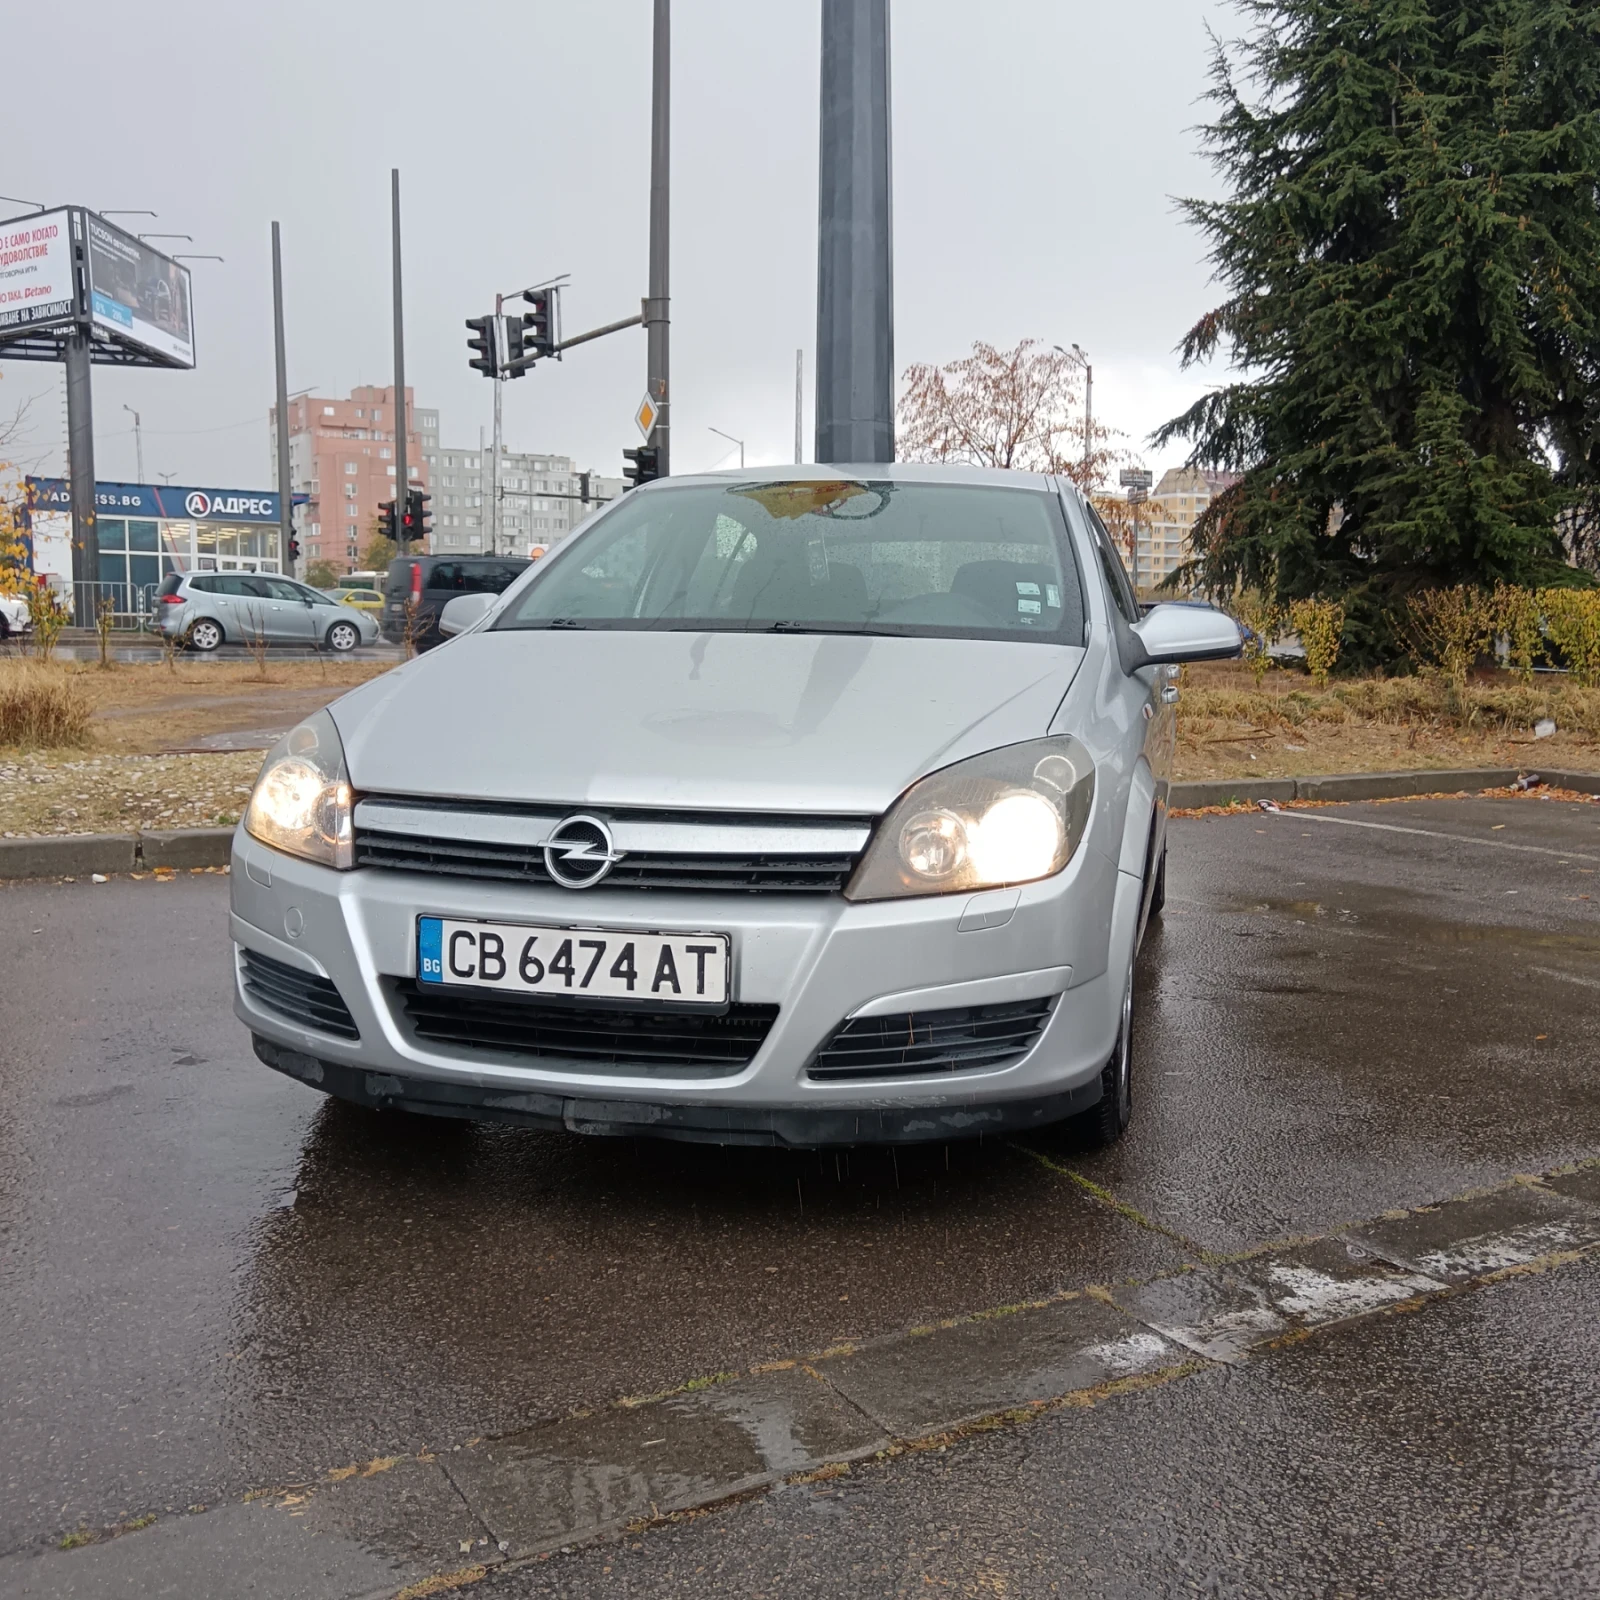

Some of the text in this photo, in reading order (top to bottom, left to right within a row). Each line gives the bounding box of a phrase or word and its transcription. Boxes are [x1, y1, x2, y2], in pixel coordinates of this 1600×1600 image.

[5, 236, 8, 248] Е
[11, 231, 30, 247] САМО
[32, 225, 58, 242] КОГАТО
[21, 308, 30, 322] НА
[31, 300, 71, 320] ЗАВИСИМОСТ
[50, 491, 141, 507] ADSS.BG
[212, 496, 273, 515] АДРЕС
[423, 957, 441, 974] BG
[449, 930, 717, 995] CB 6474 AT
